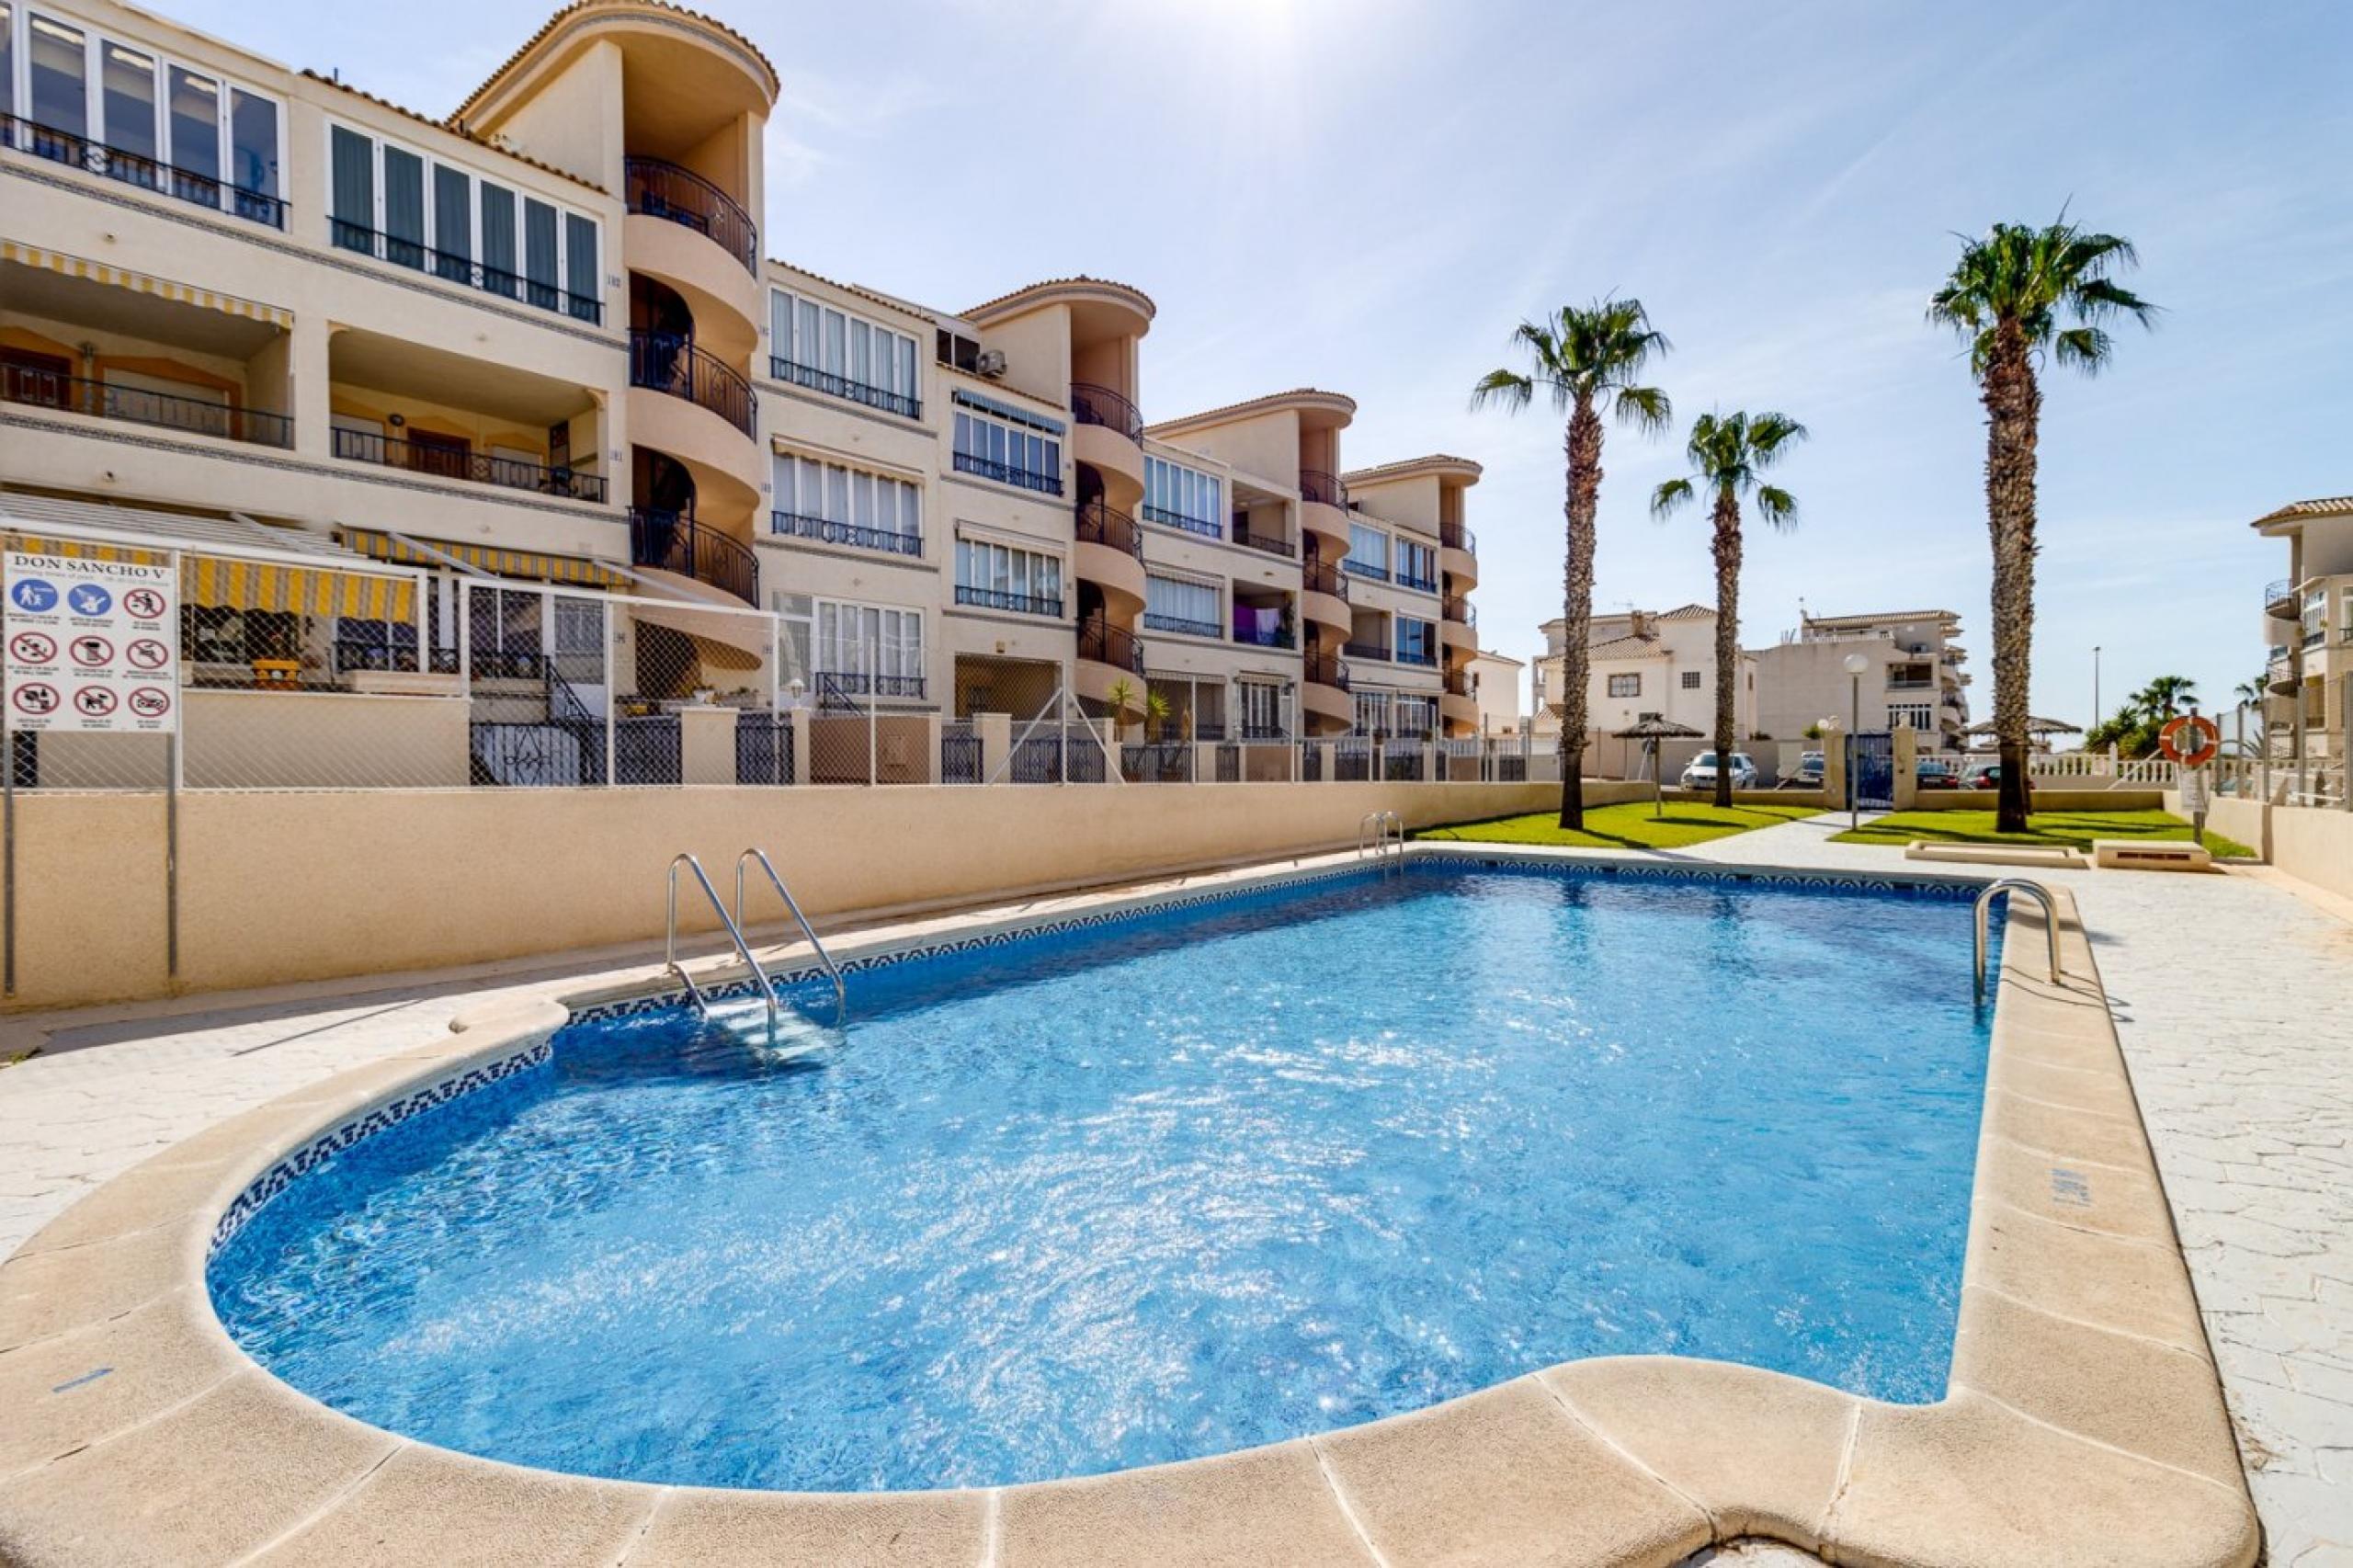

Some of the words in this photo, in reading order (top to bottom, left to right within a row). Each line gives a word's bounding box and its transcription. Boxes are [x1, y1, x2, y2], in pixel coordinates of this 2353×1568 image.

[15, 555, 61, 569] DON
[66, 559, 148, 577] SANCHO
[152, 569, 164, 579] V
